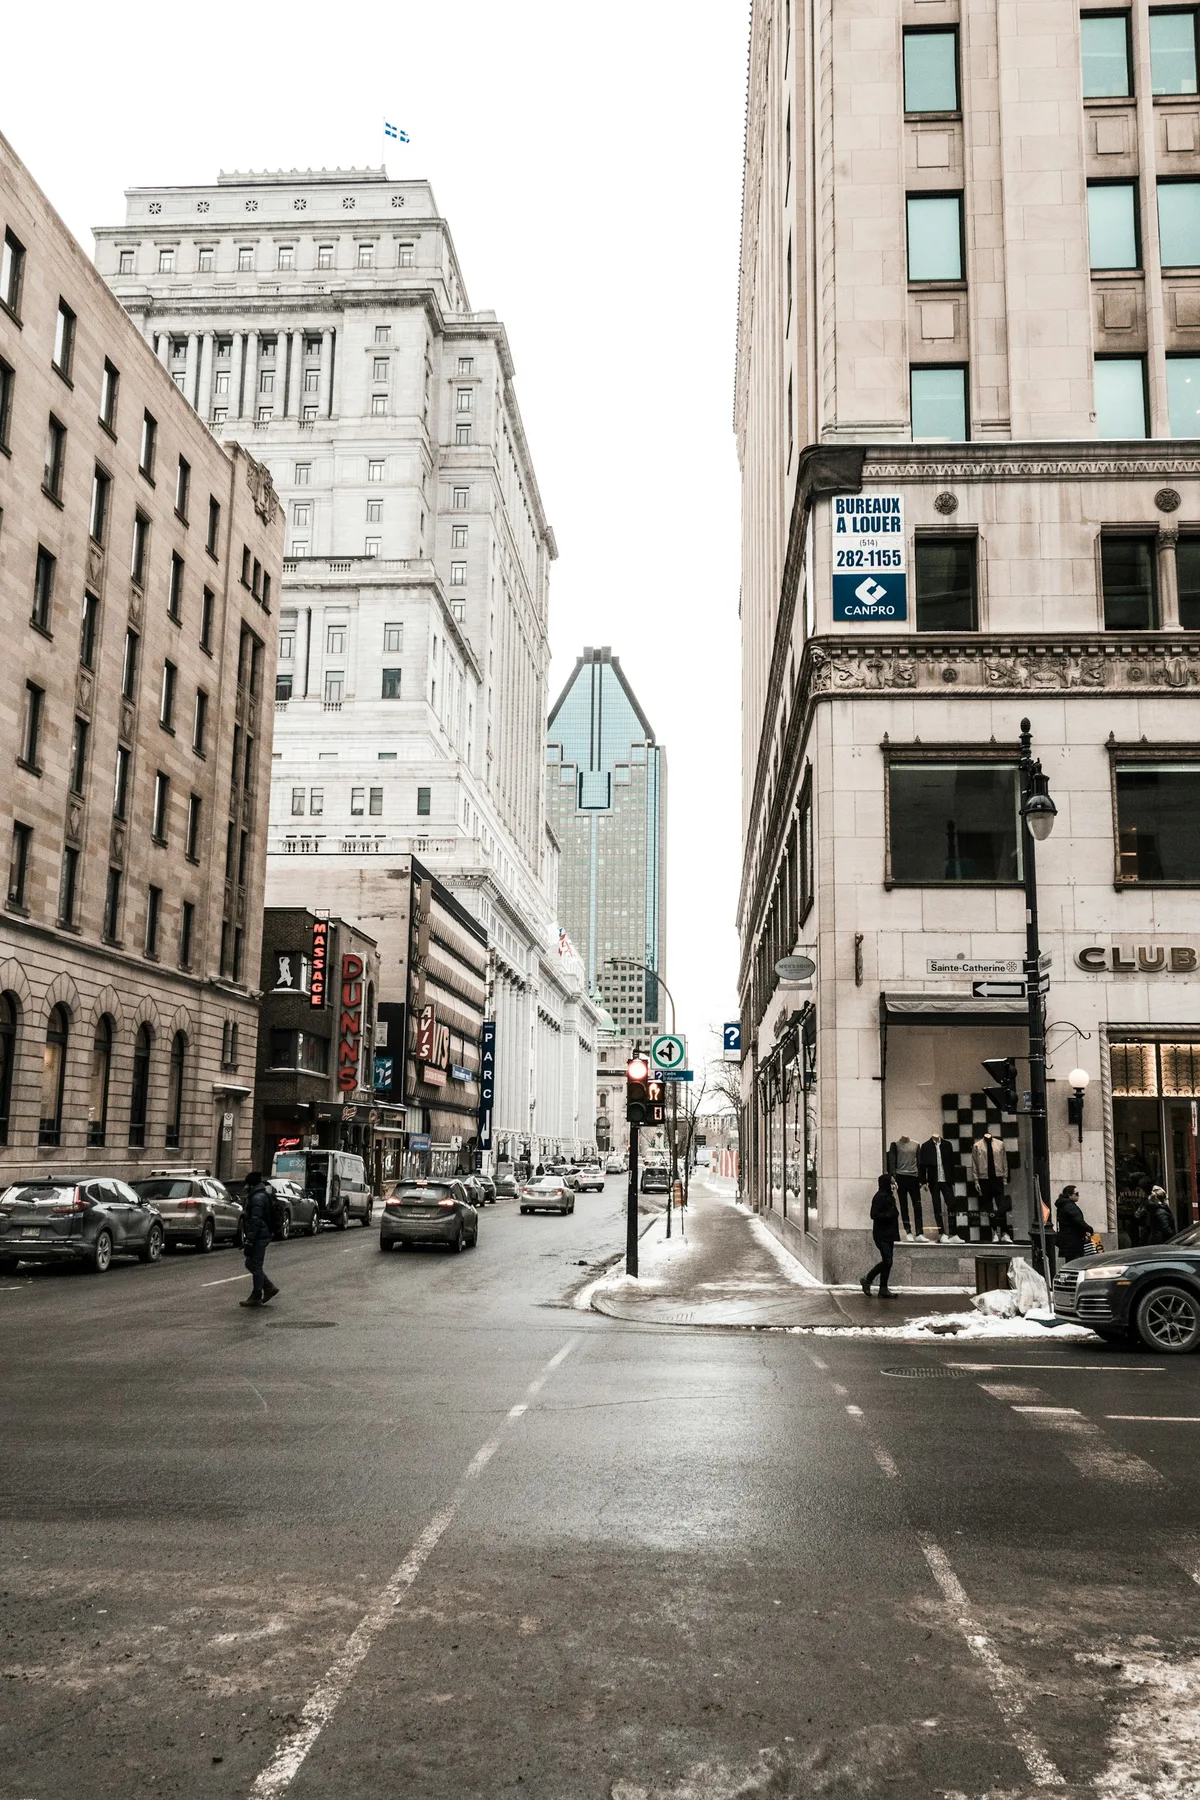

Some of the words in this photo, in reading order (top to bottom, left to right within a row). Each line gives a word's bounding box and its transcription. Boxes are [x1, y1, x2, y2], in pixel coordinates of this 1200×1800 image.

[836, 498, 900, 514] BUREAUX
[836, 517, 847, 533] A
[852, 516, 901, 533] LOUER
[859, 539, 878, 547] (514)
[836, 550, 902, 567] 282-1155
[844, 605, 895, 616] CANPRO
[311, 923, 327, 1005] MASSAGE
[1077, 946, 1198, 971] CLUB
[930, 963, 1006, 972] Sainte-Catherine
[338, 954, 363, 1091] DUNNS
[419, 1006, 432, 1057] AVIS
[482, 1033, 493, 1098] PARC
